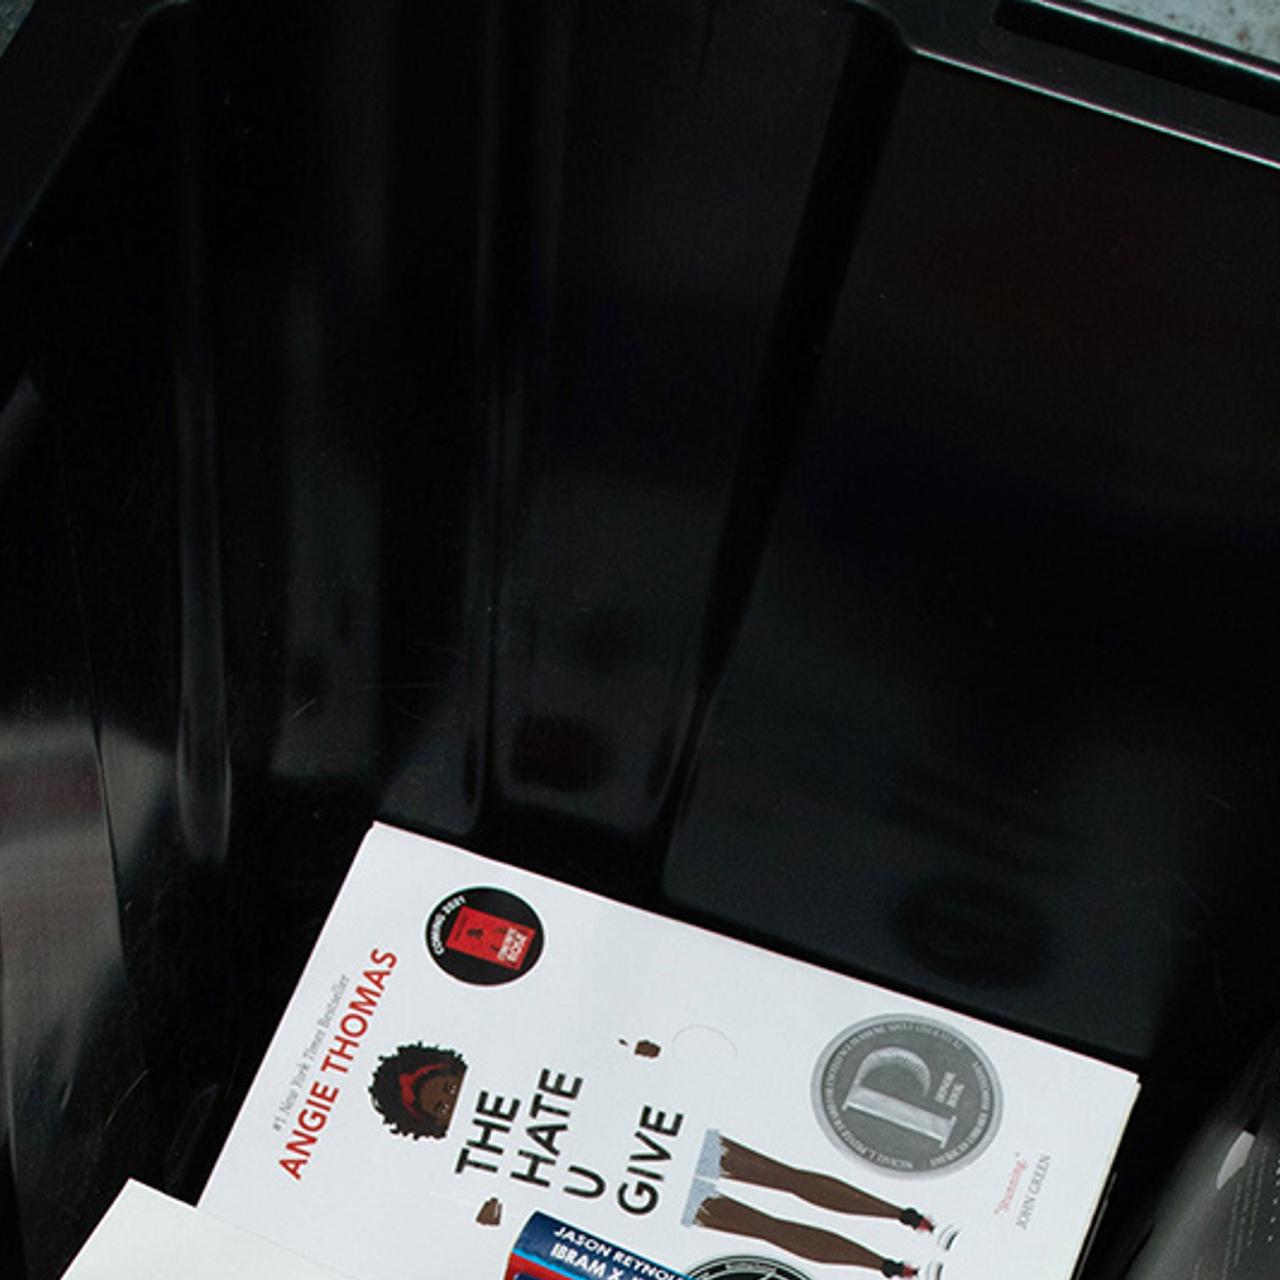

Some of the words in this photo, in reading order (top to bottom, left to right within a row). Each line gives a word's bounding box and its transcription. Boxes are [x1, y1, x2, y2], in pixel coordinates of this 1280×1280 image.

[279, 1082, 339, 1180] ANGIE
[321, 947, 398, 1074] THOMAS
[279, 1089, 297, 1113] New
[291, 1063, 309, 1087] York
[304, 1029, 325, 1060] Times
[454, 1091, 520, 1174] THE
[510, 1068, 584, 1188] HATE
[617, 1105, 684, 1215] GIVE
[563, 1165, 606, 1198] U
[1016, 1193, 1036, 1230] JOHN
[1029, 1154, 1051, 1196] GREEN
[550, 1244, 607, 1280] IBRAM
[555, 1226, 611, 1257] JASON
